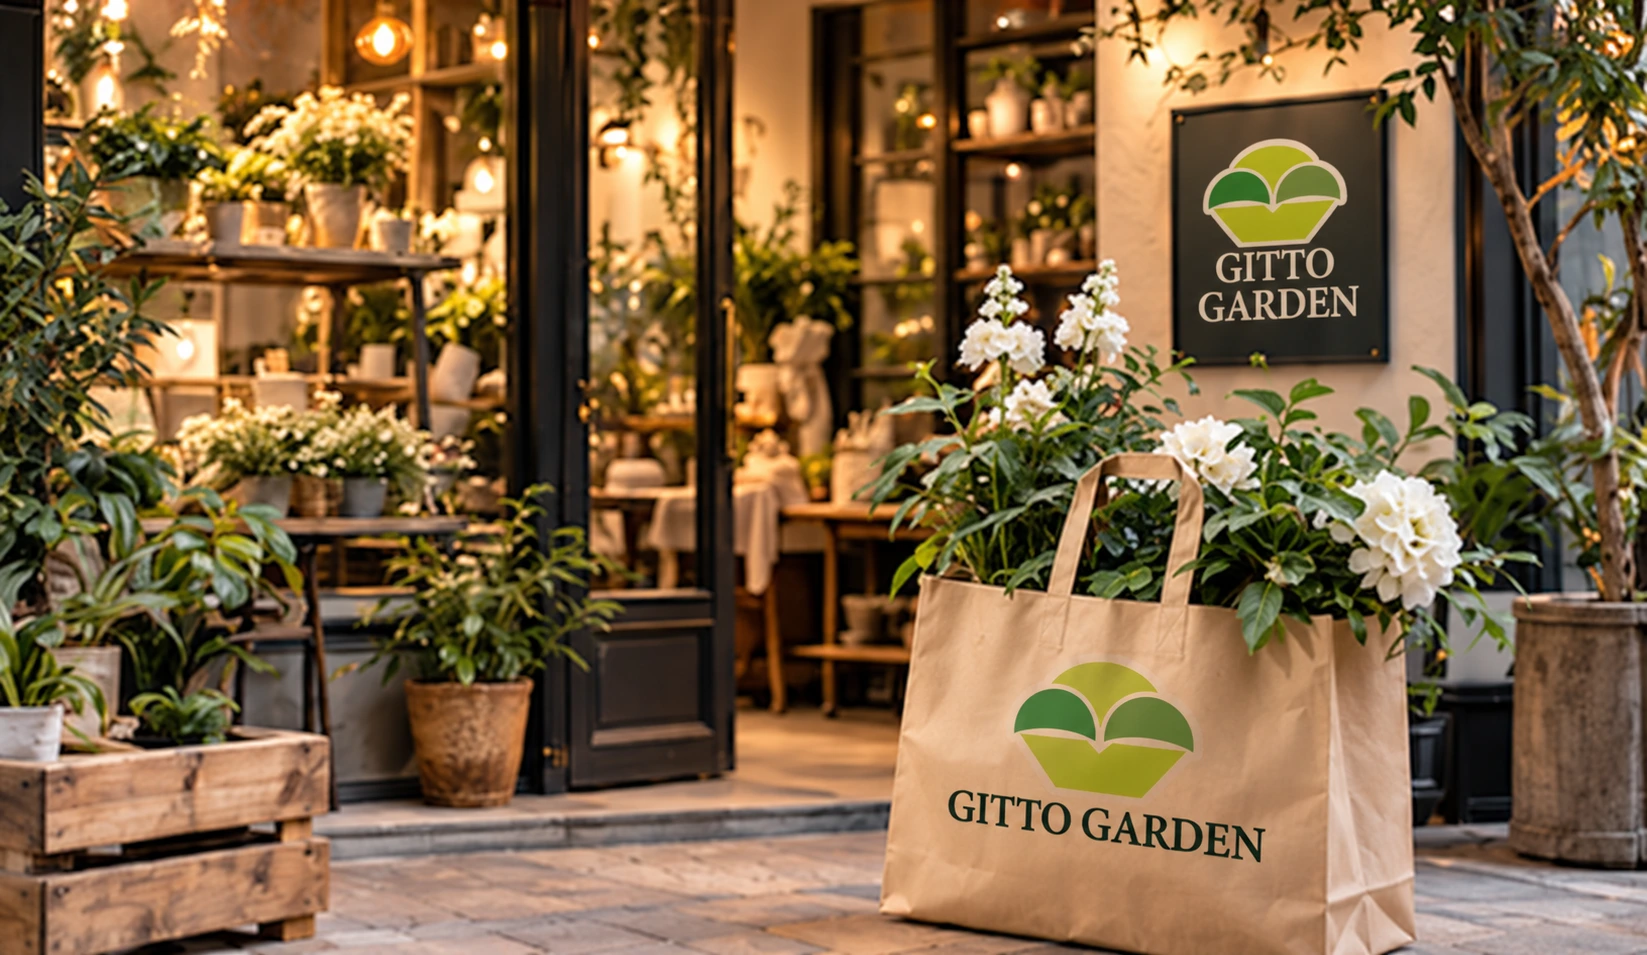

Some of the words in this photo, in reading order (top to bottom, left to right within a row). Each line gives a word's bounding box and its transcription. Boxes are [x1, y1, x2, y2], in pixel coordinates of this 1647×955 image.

[1215, 247, 1335, 284] GITTO
[1198, 285, 1360, 323] GARDEN
[947, 789, 1072, 835] GITTO
[1081, 807, 1266, 863] GARDEN
